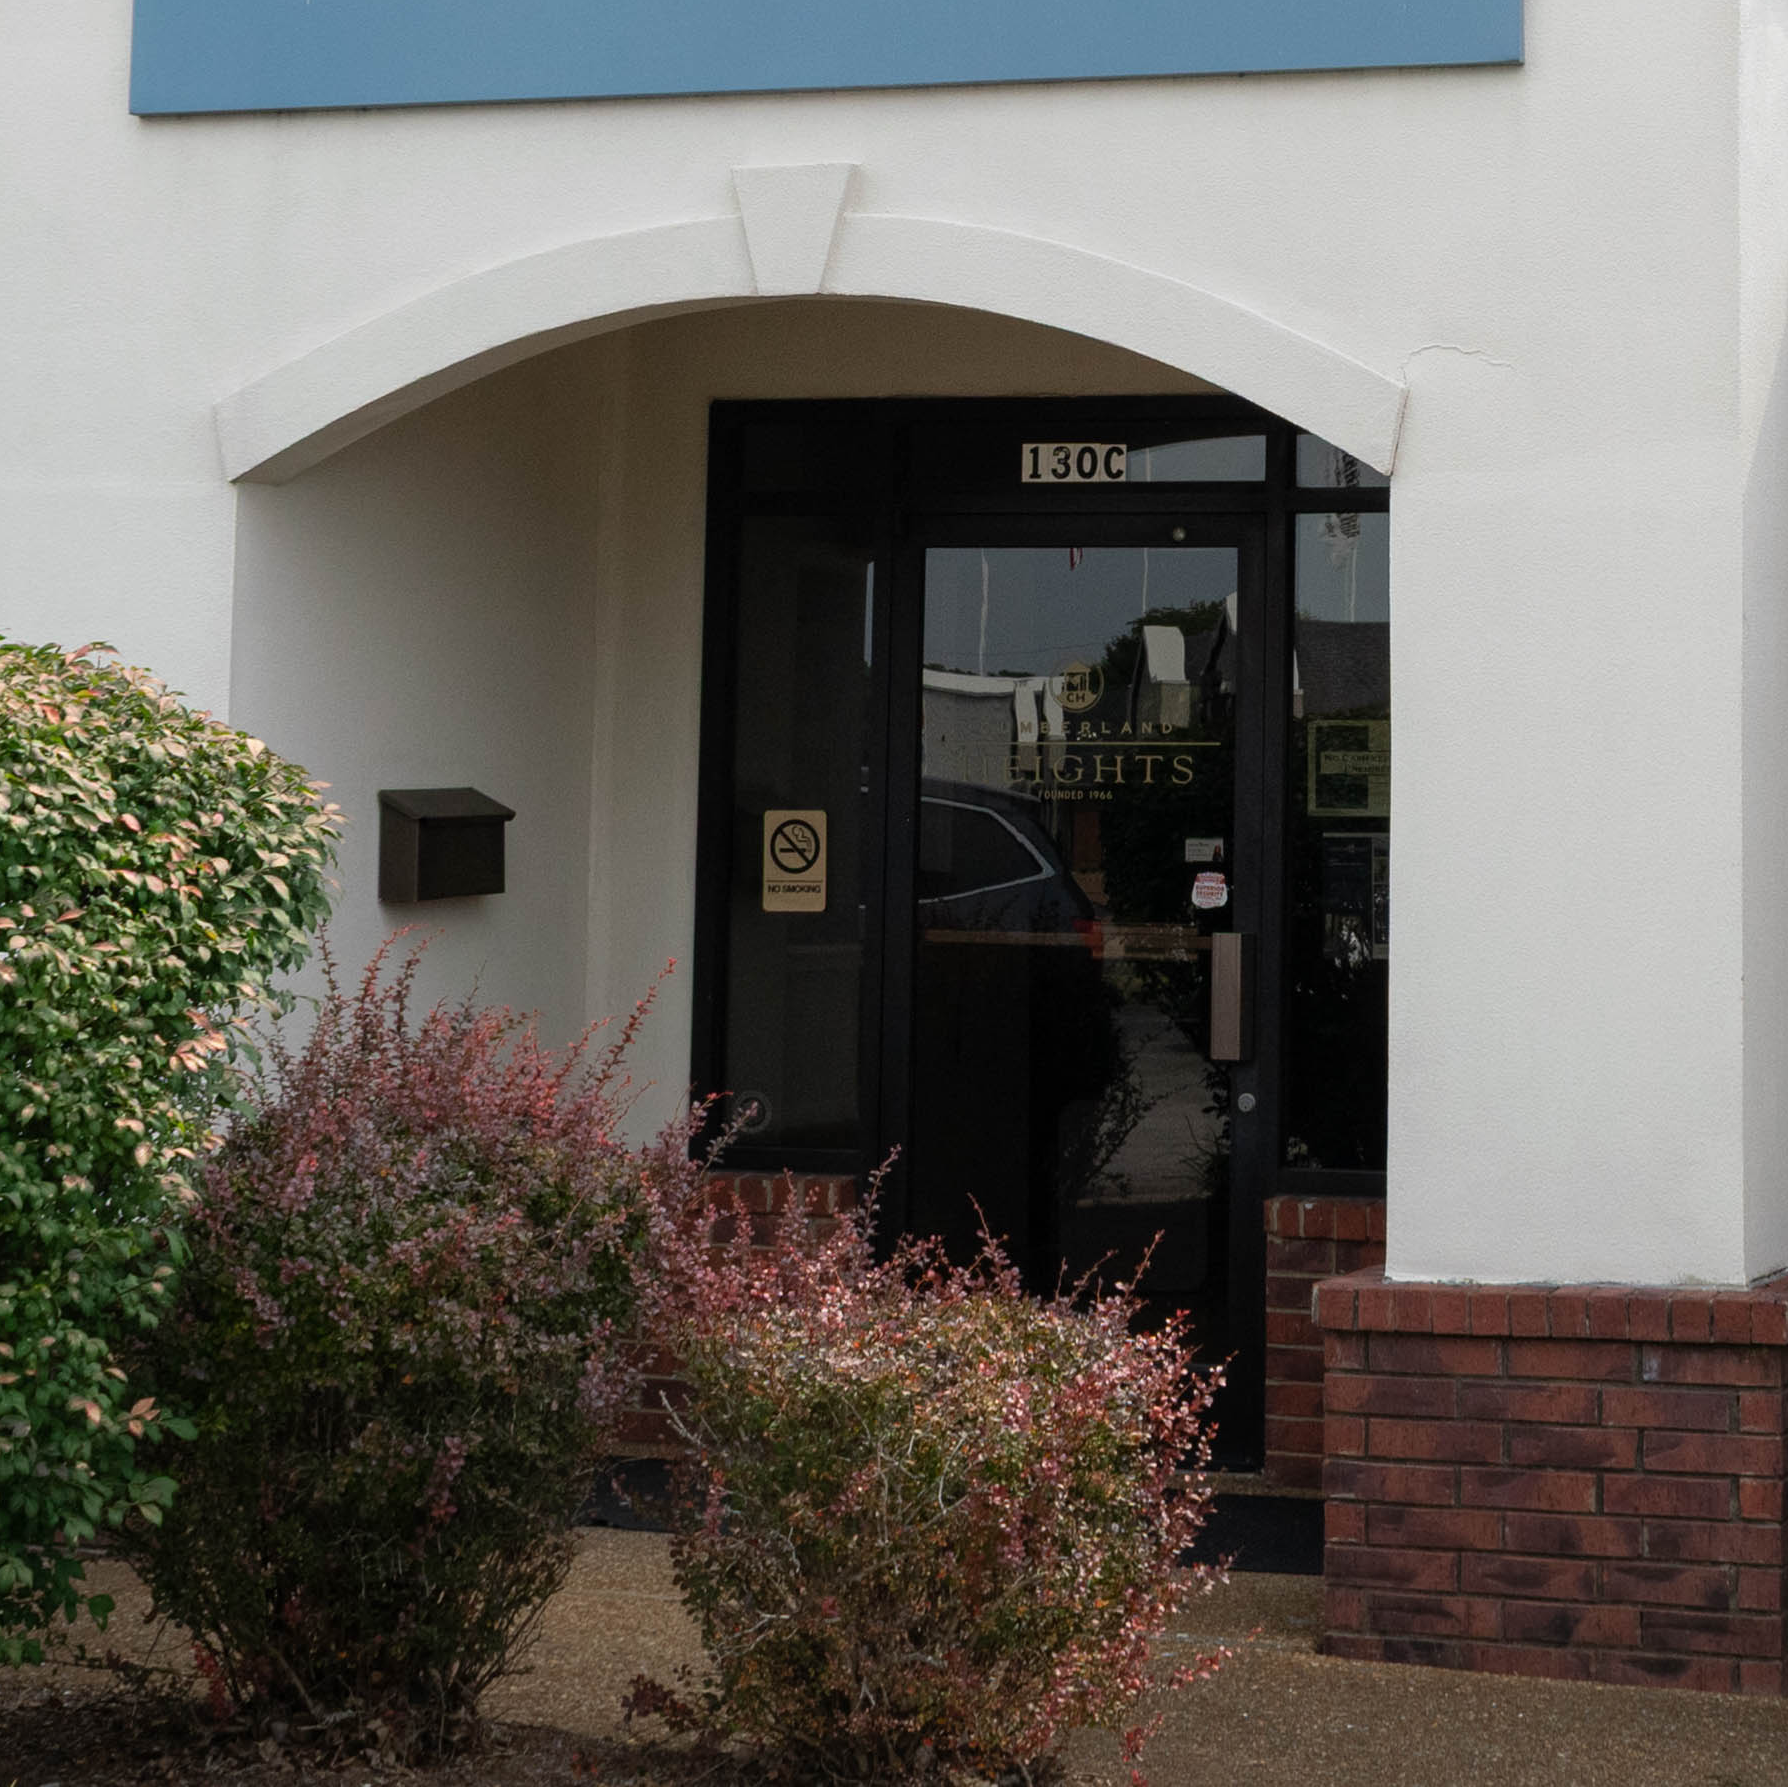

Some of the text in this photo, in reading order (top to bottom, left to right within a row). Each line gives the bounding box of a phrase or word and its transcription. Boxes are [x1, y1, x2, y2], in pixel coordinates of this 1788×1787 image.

[1028, 445, 1125, 480] 130C
[1065, 692, 1086, 703] CH
[963, 754, 1194, 785] HEIGHTS
[1039, 789, 1113, 801] FOUNDED 1966
[767, 884, 822, 893] NO SMOKING
